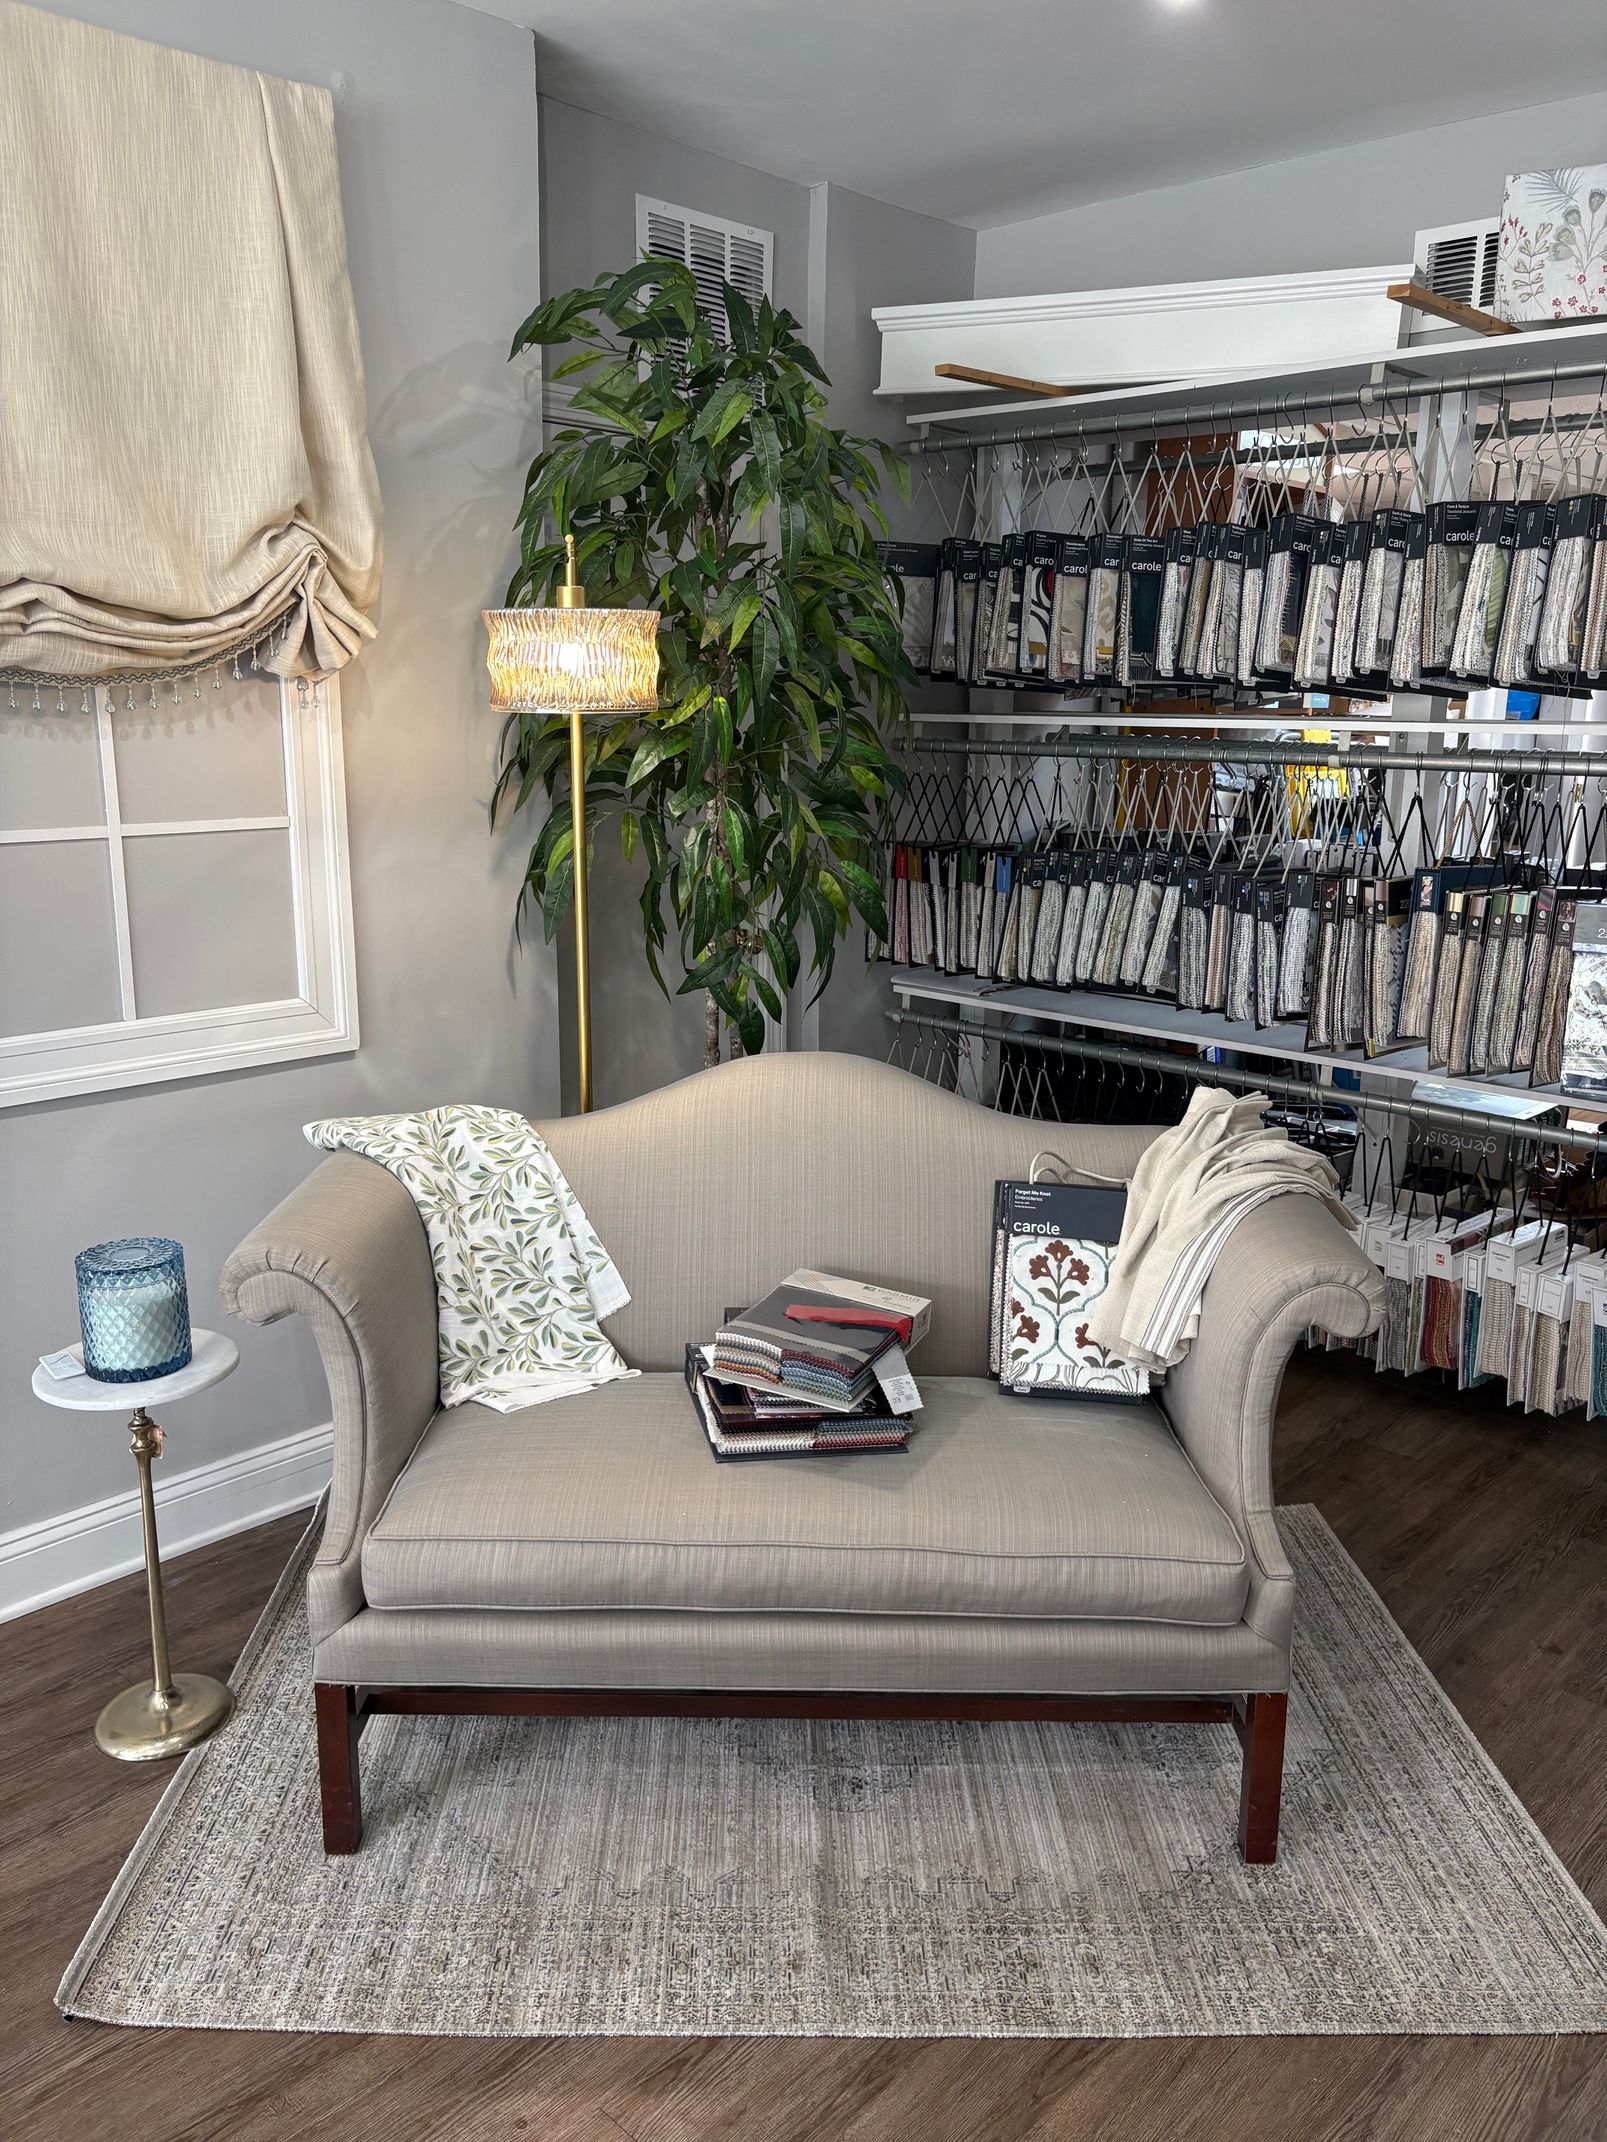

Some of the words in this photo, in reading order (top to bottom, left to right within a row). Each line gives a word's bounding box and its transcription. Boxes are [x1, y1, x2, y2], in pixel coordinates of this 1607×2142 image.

[1446, 529, 1475, 541] carole
[1293, 541, 1312, 553] caro
[1388, 538, 1403, 548] car
[1228, 550, 1242, 560] car
[1034, 556, 1054, 566] caro
[1104, 558, 1120, 566] car
[1131, 561, 1162, 571] carole
[1063, 564, 1088, 574] carol
[963, 572, 977, 580] car
[1430, 1131, 1497, 1154] genesis
[1015, 1188, 1031, 1196] Forget
[1013, 1221, 1060, 1235] carole
